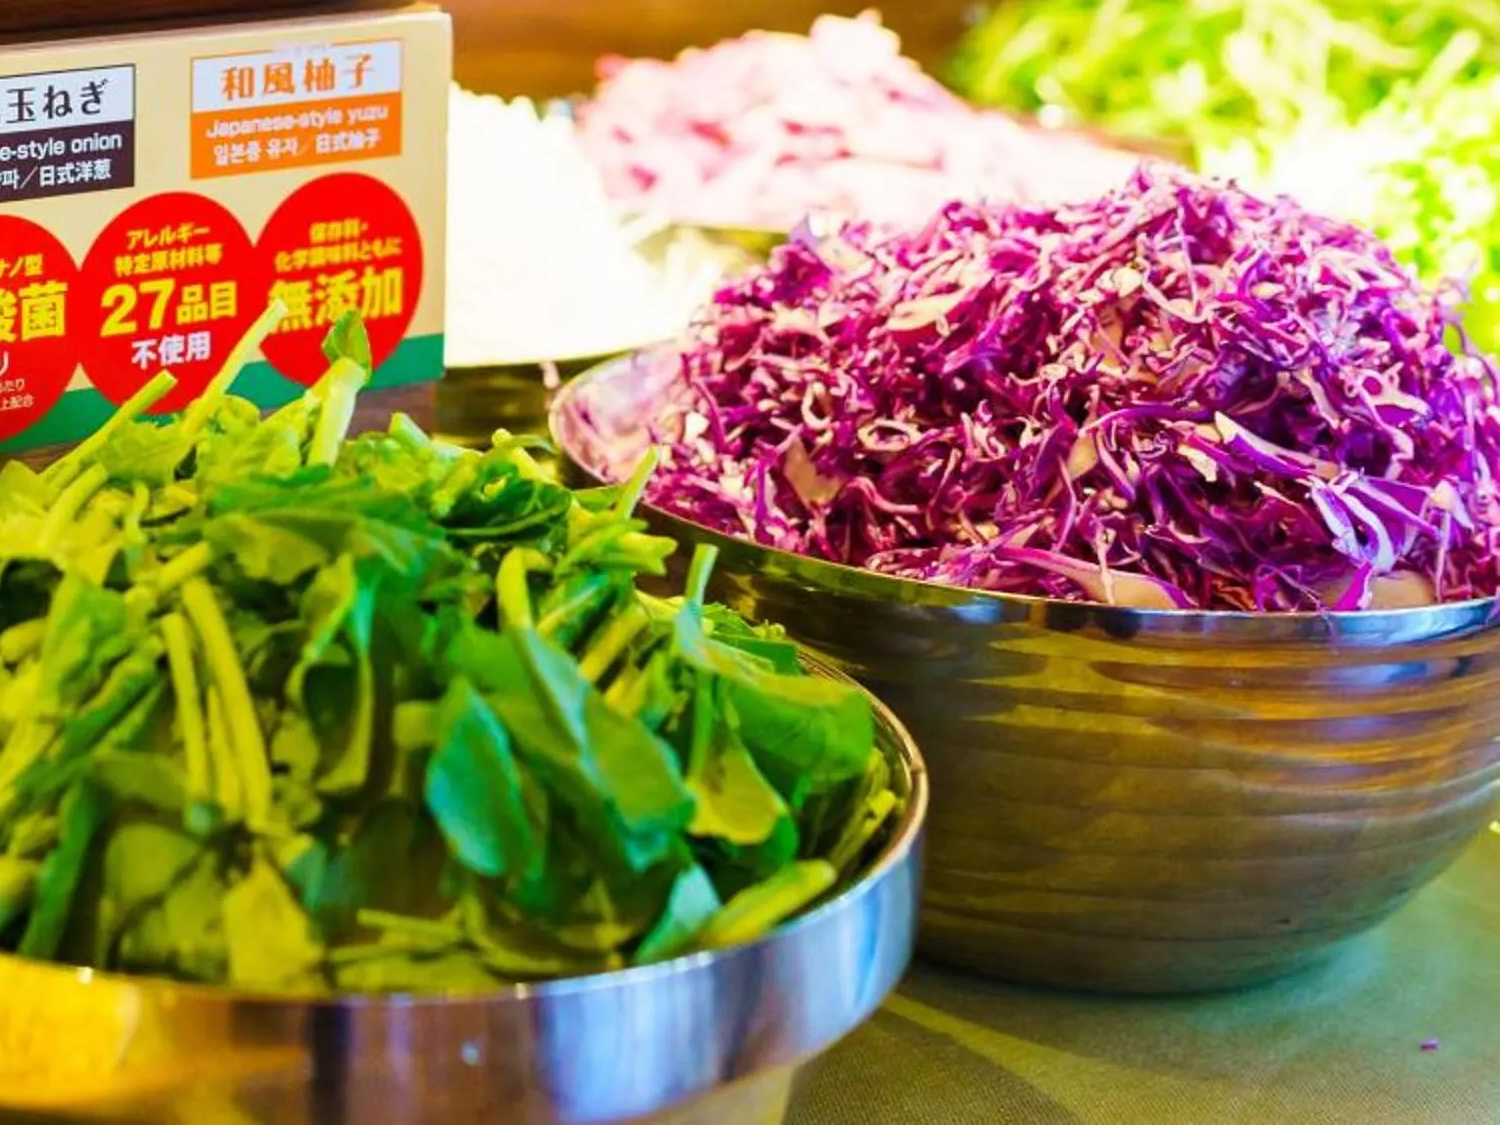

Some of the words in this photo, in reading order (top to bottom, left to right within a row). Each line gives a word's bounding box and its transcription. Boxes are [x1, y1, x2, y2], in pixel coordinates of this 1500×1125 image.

[217, 53, 375, 101] 和風柚子
[205, 106, 343, 139] Japanese-style
[346, 105, 389, 125] yuzu
[70, 131, 123, 153] onion
[126, 223, 211, 250] アレルギー
[113, 242, 224, 278] 特定原材料等
[99, 277, 238, 339] 27品目
[268, 266, 404, 336] 無添加
[130, 330, 213, 371] 不使用
